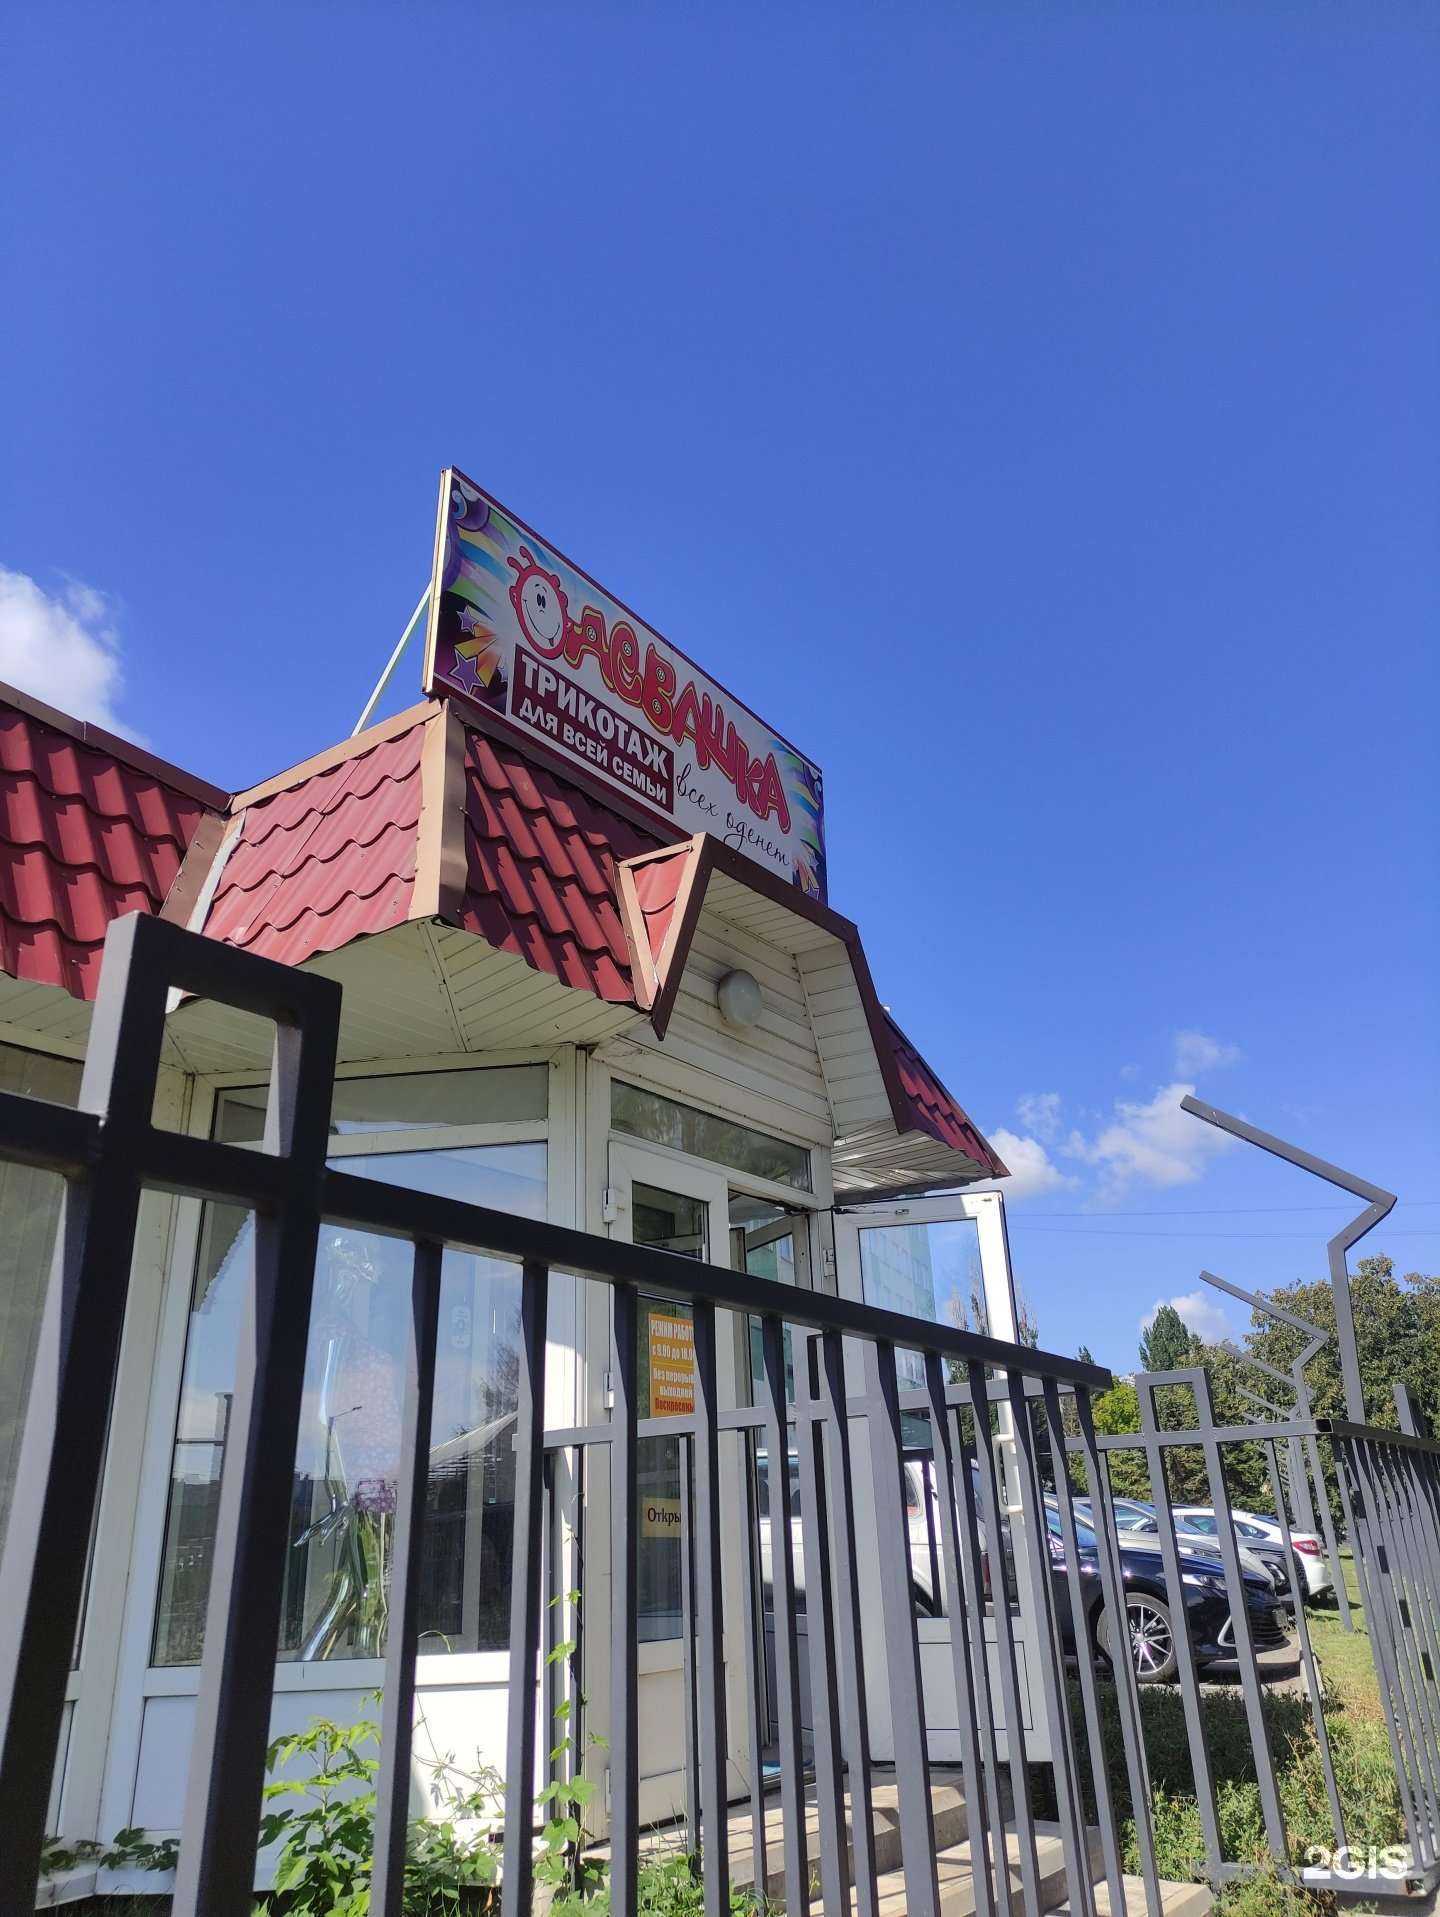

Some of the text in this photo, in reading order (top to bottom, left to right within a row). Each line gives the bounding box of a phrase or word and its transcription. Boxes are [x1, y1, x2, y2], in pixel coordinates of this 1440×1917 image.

[521, 654, 669, 780] ТРИКОТАЖ
[519, 697, 667, 805] ДЛЯ ВСЕЙ СЕМЬИ
[676, 762, 790, 866] всех оденет
[651, 1320, 694, 1342] РЕЖИМ РАБОТ
[681, 1348, 694, 1361] 18.0
[647, 1507, 682, 1527] Откры
